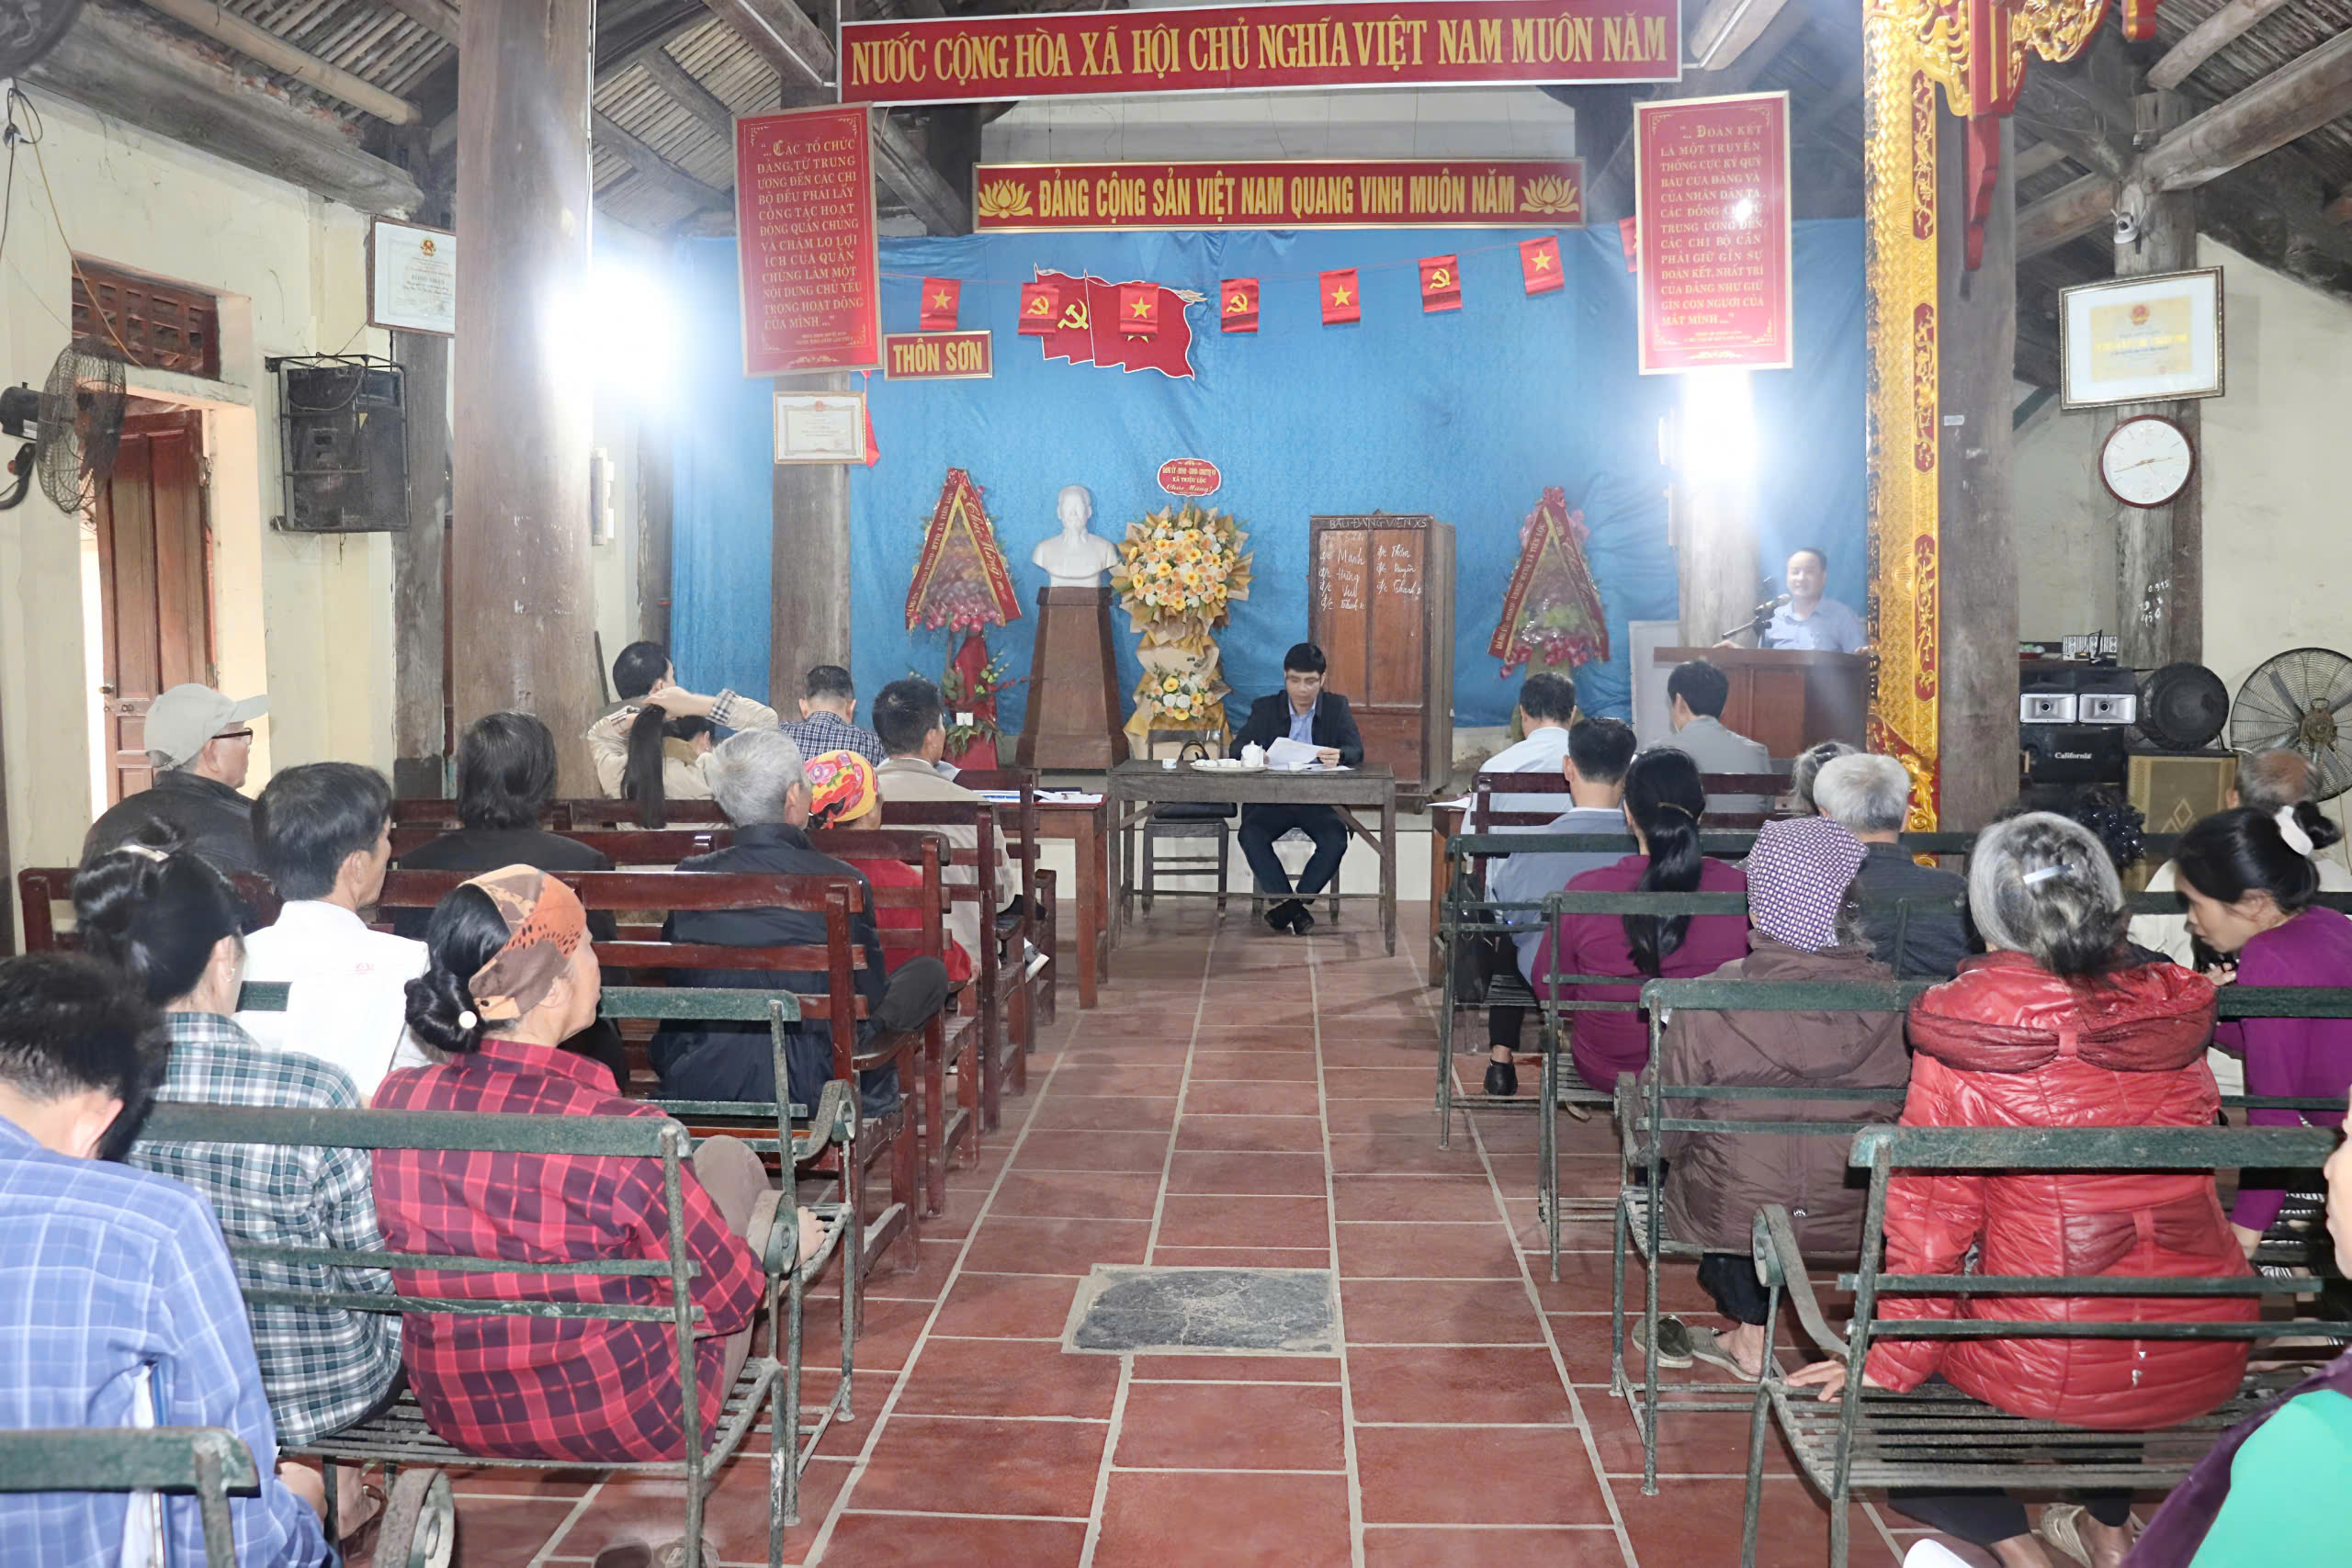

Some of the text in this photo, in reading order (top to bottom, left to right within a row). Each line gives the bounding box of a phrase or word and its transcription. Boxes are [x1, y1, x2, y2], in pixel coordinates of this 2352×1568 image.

[851, 10, 1668, 85] NƯỚC CỘNG HÒA XÃ HỘI CHỦ NGHĨA VIỆT NAM MUÔN NĂM
[813, 155, 855, 169] TRUNG
[837, 171, 856, 183] CHI
[1038, 167, 1515, 224] ĐẢNG CỘNG SẢN VIỆT NAM QUANG VINH MUÔN NĂM
[1661, 222, 1698, 235] TRUNG
[817, 236, 832, 248] LO
[1689, 235, 1710, 248] CHI
[785, 286, 813, 298] DUNG
[1683, 298, 1704, 310] CON
[893, 338, 983, 373] THÔN SƠN
[2054, 751, 2092, 760] California
